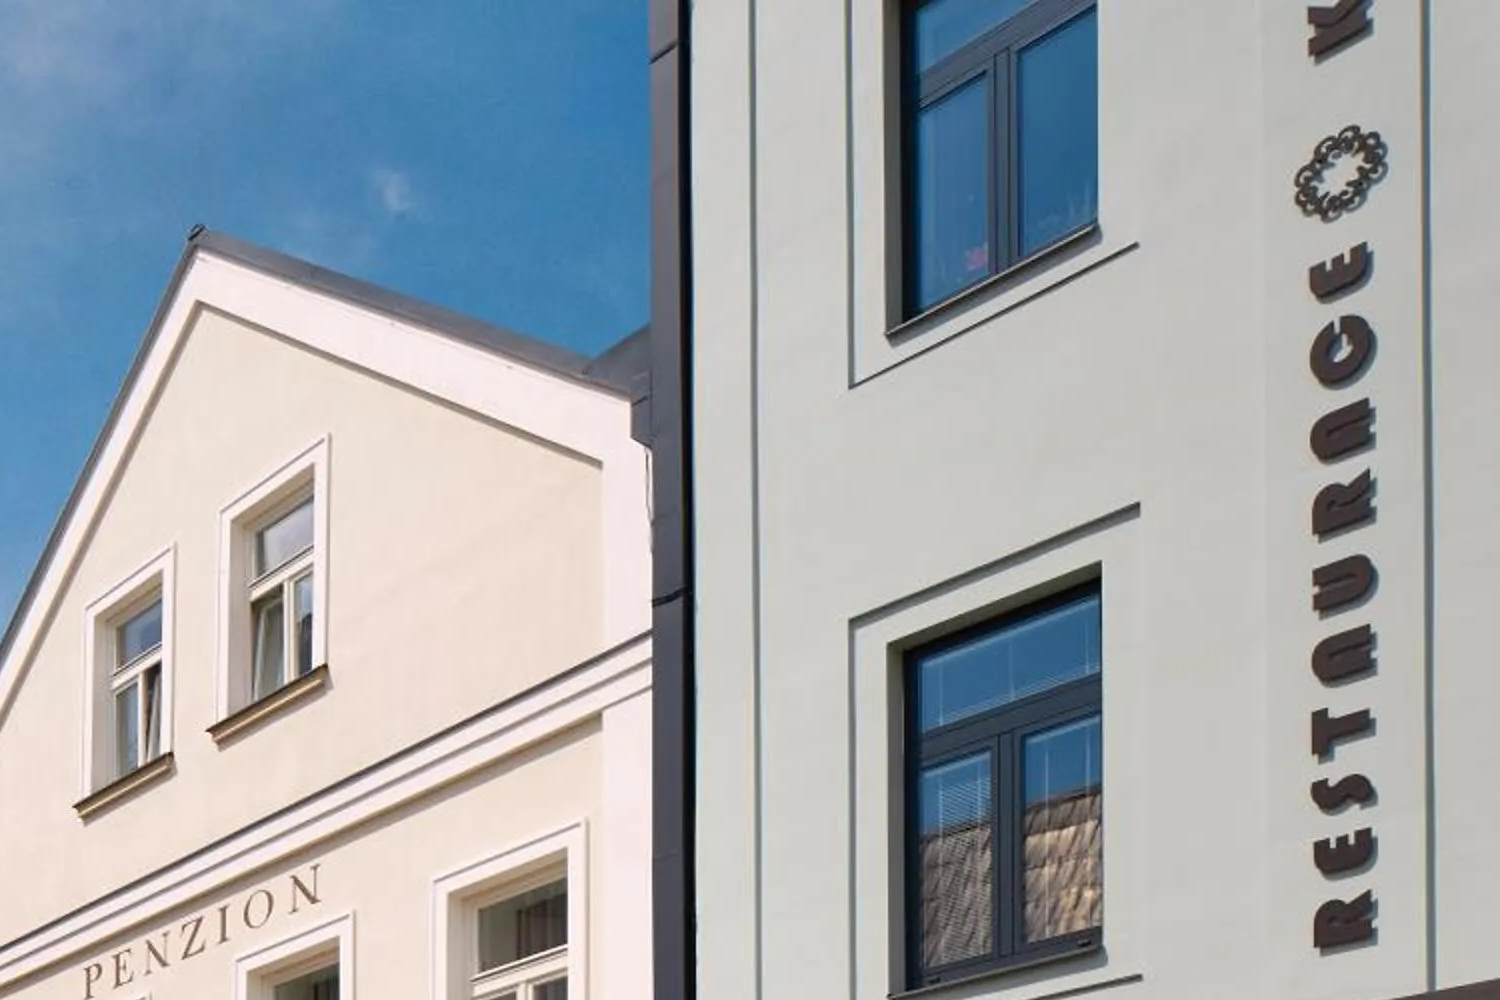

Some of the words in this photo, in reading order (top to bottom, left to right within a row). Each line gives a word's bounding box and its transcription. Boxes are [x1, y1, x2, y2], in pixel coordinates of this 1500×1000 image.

[1308, 0, 1373, 64] K
[1307, 240, 1376, 952] RESTAURACE
[83, 863, 322, 1000] PENZION
